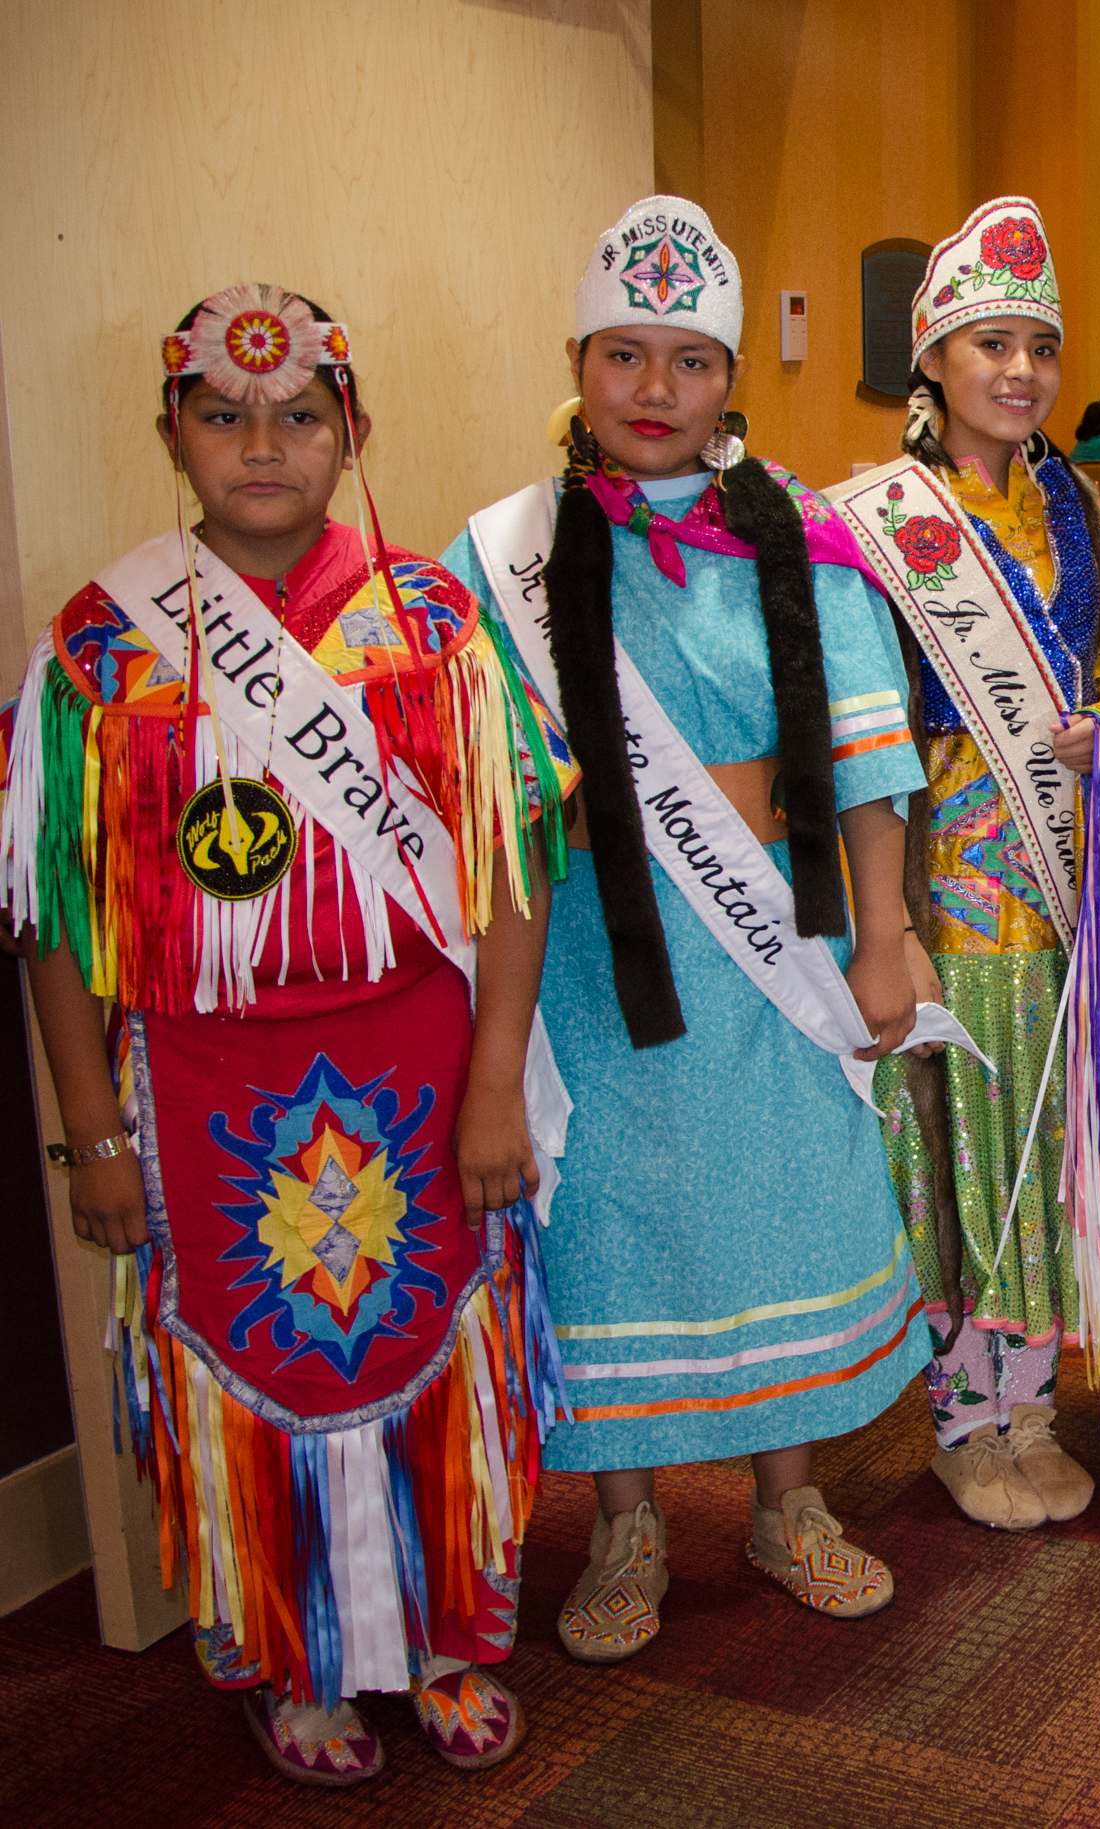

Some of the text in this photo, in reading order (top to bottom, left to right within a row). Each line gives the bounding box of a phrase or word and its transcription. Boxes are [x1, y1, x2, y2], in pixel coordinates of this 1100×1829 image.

[601, 215, 729, 287] JR MISS UTE MTN
[151, 569, 424, 868] Little Brave
[969, 652, 1030, 736] Miss
[1025, 741, 1062, 808] Ute
[644, 785, 783, 966] Mountain
